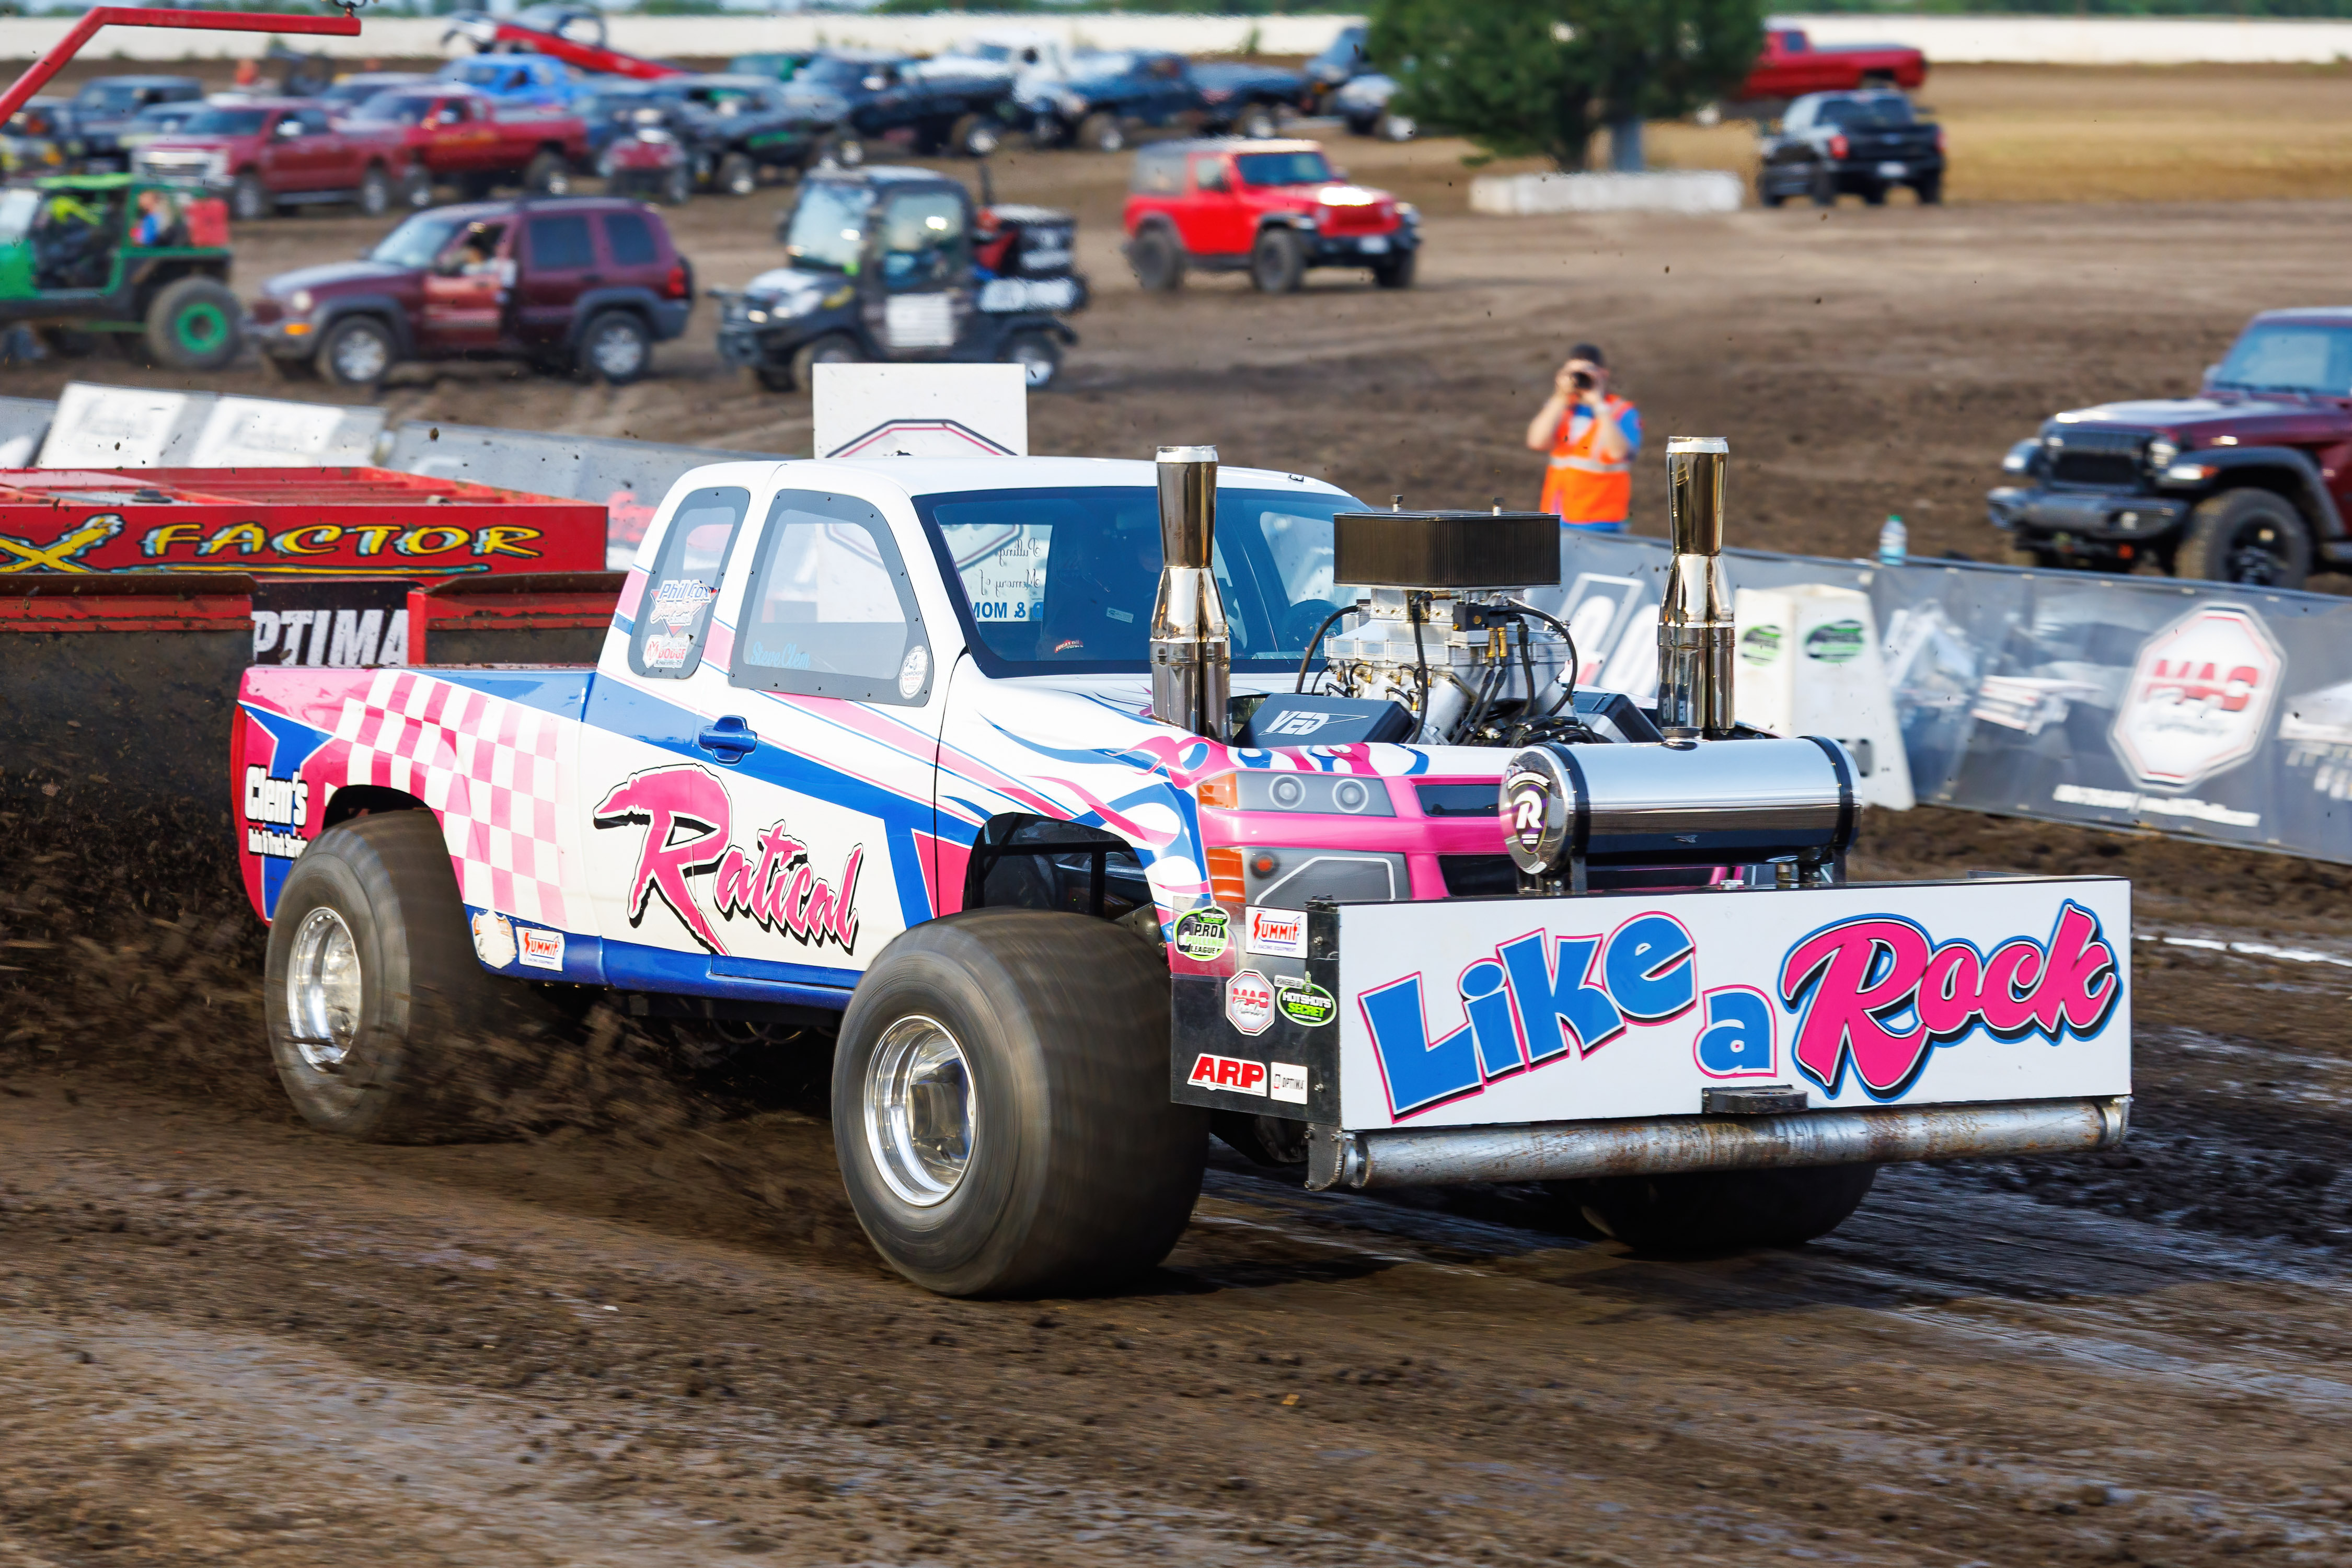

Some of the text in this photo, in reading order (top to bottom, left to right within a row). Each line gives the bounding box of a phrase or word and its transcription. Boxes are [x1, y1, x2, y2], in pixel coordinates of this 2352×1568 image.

[140, 522, 544, 558] FACTOR
[658, 582, 689, 601] Phil
[251, 609, 409, 666] PTIMA
[1055, 641, 1071, 651] LUCAS
[659, 649, 686, 659] DODGE
[750, 641, 810, 669] Steve Clem
[245, 765, 308, 826] Clem's
[1513, 790, 1543, 829] R
[593, 764, 864, 956] Ratical
[1185, 935, 1225, 948] PULLING
[1194, 923, 1218, 938] PRO
[1191, 945, 1216, 954] LEAGUE
[1232, 988, 1269, 1008] MAC
[1287, 1002, 1326, 1018] SECRET
[1358, 899, 2123, 1124] Like a Rock
[1192, 1056, 1264, 1089] ARP
